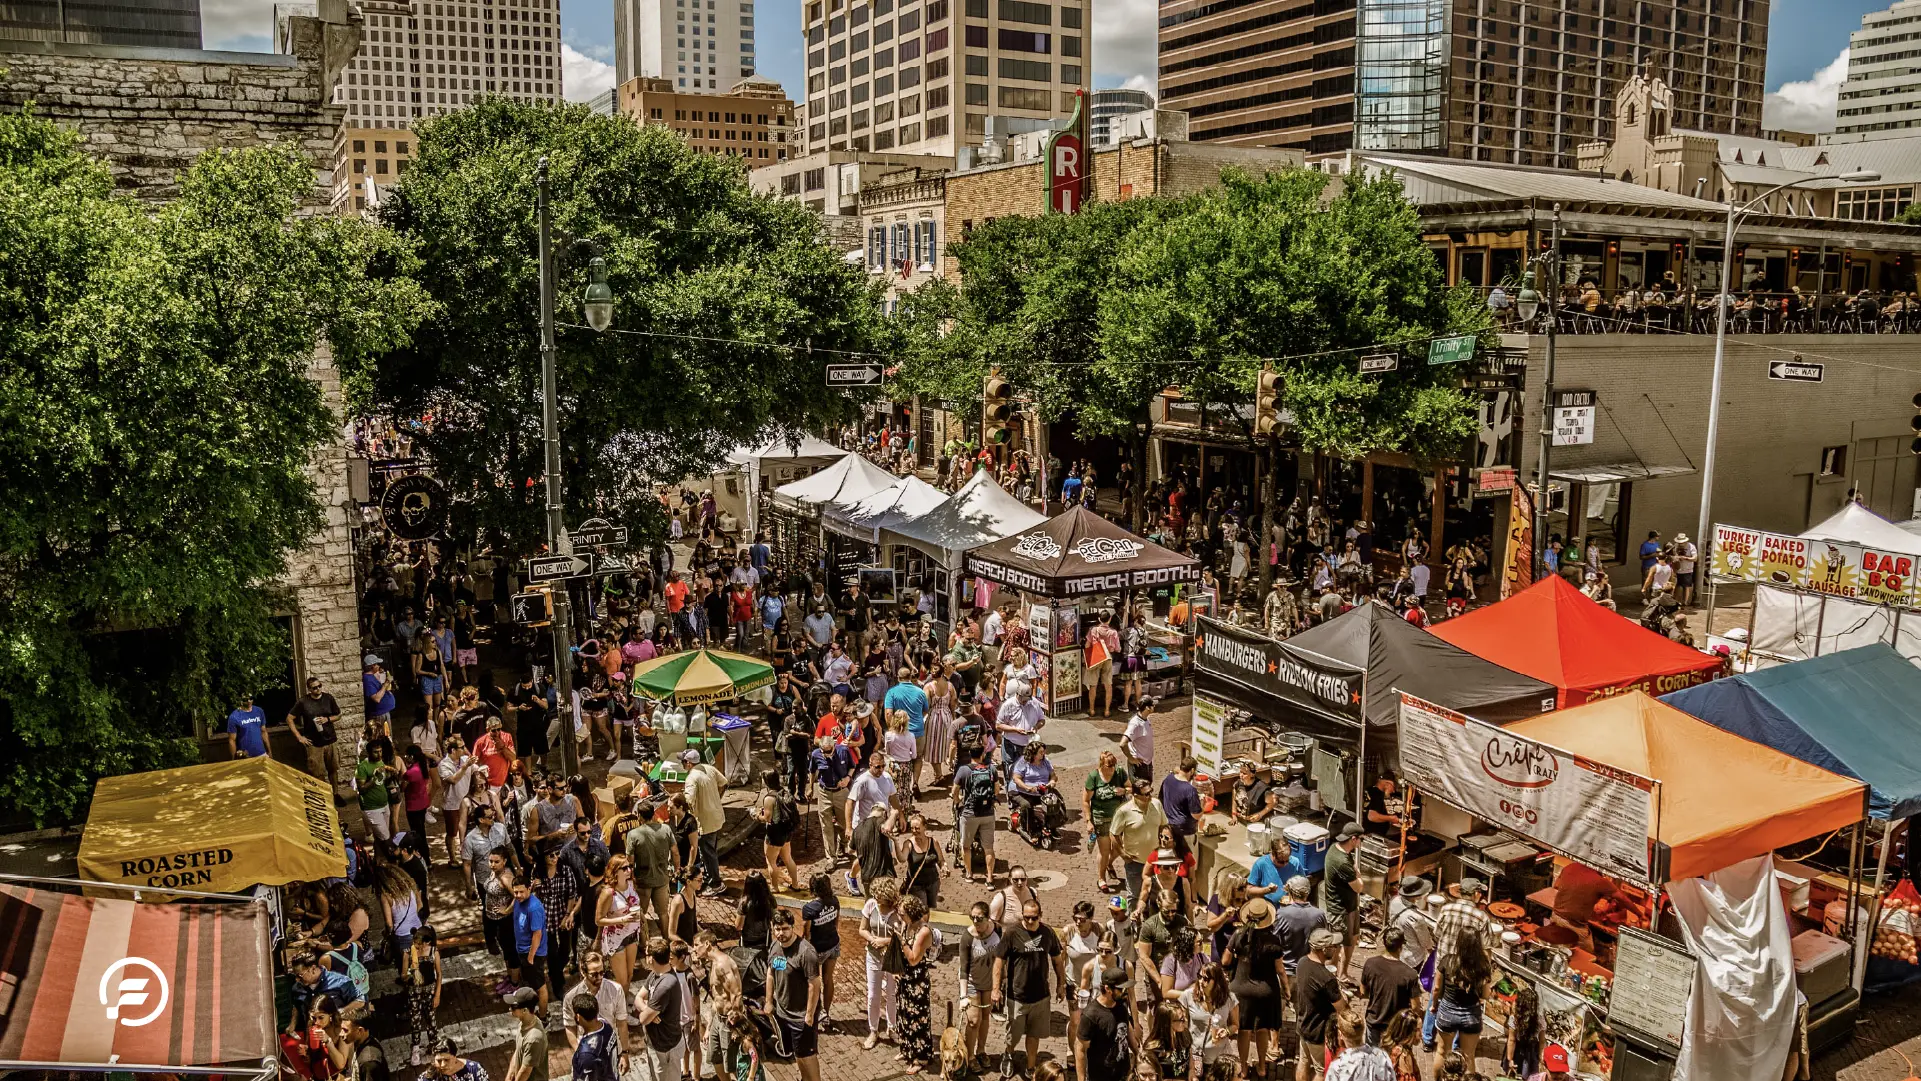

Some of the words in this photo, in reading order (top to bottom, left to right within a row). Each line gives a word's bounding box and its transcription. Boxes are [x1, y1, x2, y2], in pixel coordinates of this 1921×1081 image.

[1436, 341, 1460, 353] Trinity
[1718, 530, 1758, 545] TURKEY
[1765, 538, 1804, 552] BAKED
[1080, 538, 1134, 556] PECAN
[1723, 541, 1750, 555] LEGS
[536, 565, 553, 574] ONE
[556, 562, 573, 572] WAY
[1762, 550, 1805, 568] POTATO
[1863, 552, 1912, 576] BAR
[968, 557, 1005, 580] MERCH
[1006, 566, 1046, 592] BOOTH
[1065, 572, 1129, 593] MERCH
[1134, 565, 1192, 586] BOOTH
[1808, 580, 1855, 597] SAUSAGE
[1859, 587, 1910, 604] SANDWICHES
[1205, 633, 1266, 674] HAMBURGERS
[1278, 658, 1316, 693] RIBBON
[1316, 672, 1348, 705] FRIES
[736, 676, 774, 693] LEMONADE
[1657, 674, 1690, 692] CORN
[678, 690, 733, 703] LEMONADE
[1407, 696, 1453, 719] SAVORY
[1487, 738, 1544, 775] Crêpe
[1533, 765, 1558, 781] CRAZY
[1586, 760, 1638, 785] SWEET
[120, 848, 233, 878] ROASTED
[147, 869, 212, 888] CORN
